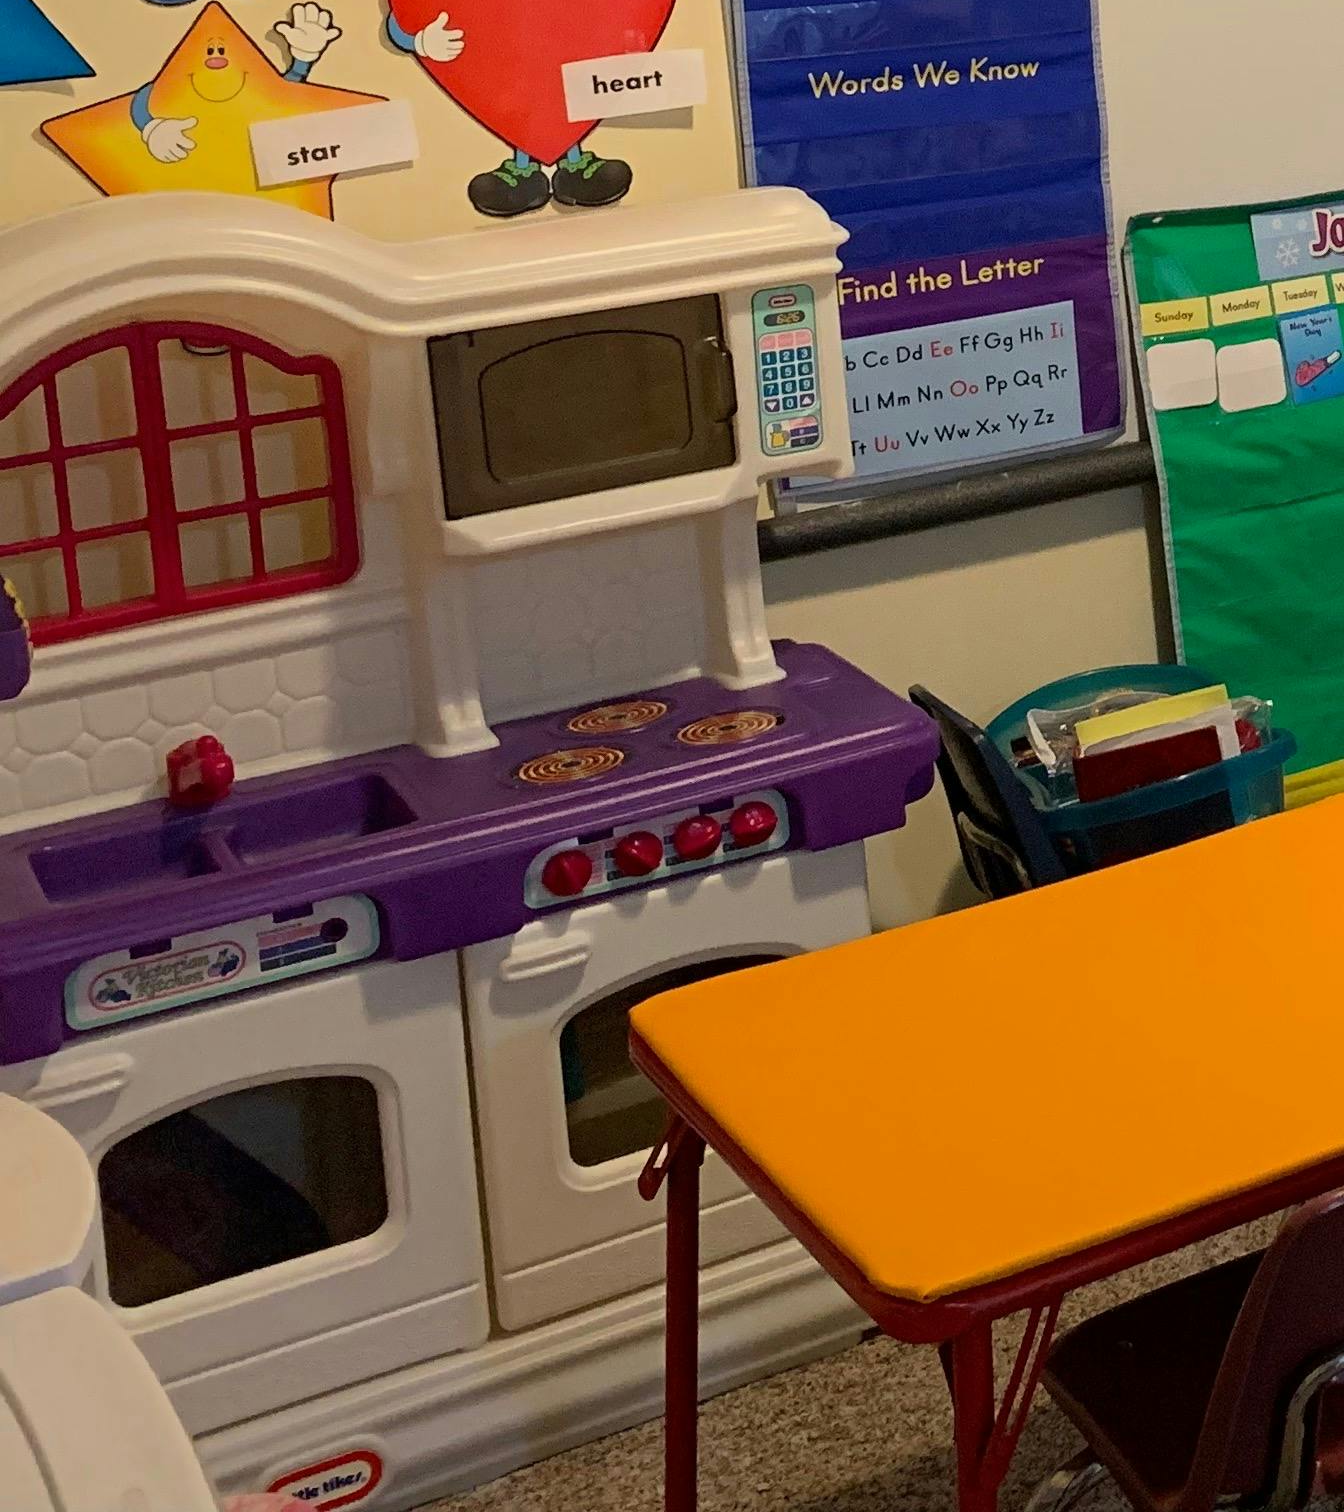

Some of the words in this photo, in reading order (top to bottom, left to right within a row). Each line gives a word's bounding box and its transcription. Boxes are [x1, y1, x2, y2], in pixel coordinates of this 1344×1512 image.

[591, 71, 663, 94] heart
[808, 67, 903, 99] Words
[914, 63, 960, 86] We
[970, 58, 1040, 82] Know
[287, 143, 341, 166] star
[838, 268, 897, 306] Find
[906, 268, 952, 294] the
[961, 256, 1044, 287] Letter
[1222, 298, 1260, 312] Monday
[1283, 288, 1318, 303] Tuesday
[1155, 310, 1193, 323] Sunday
